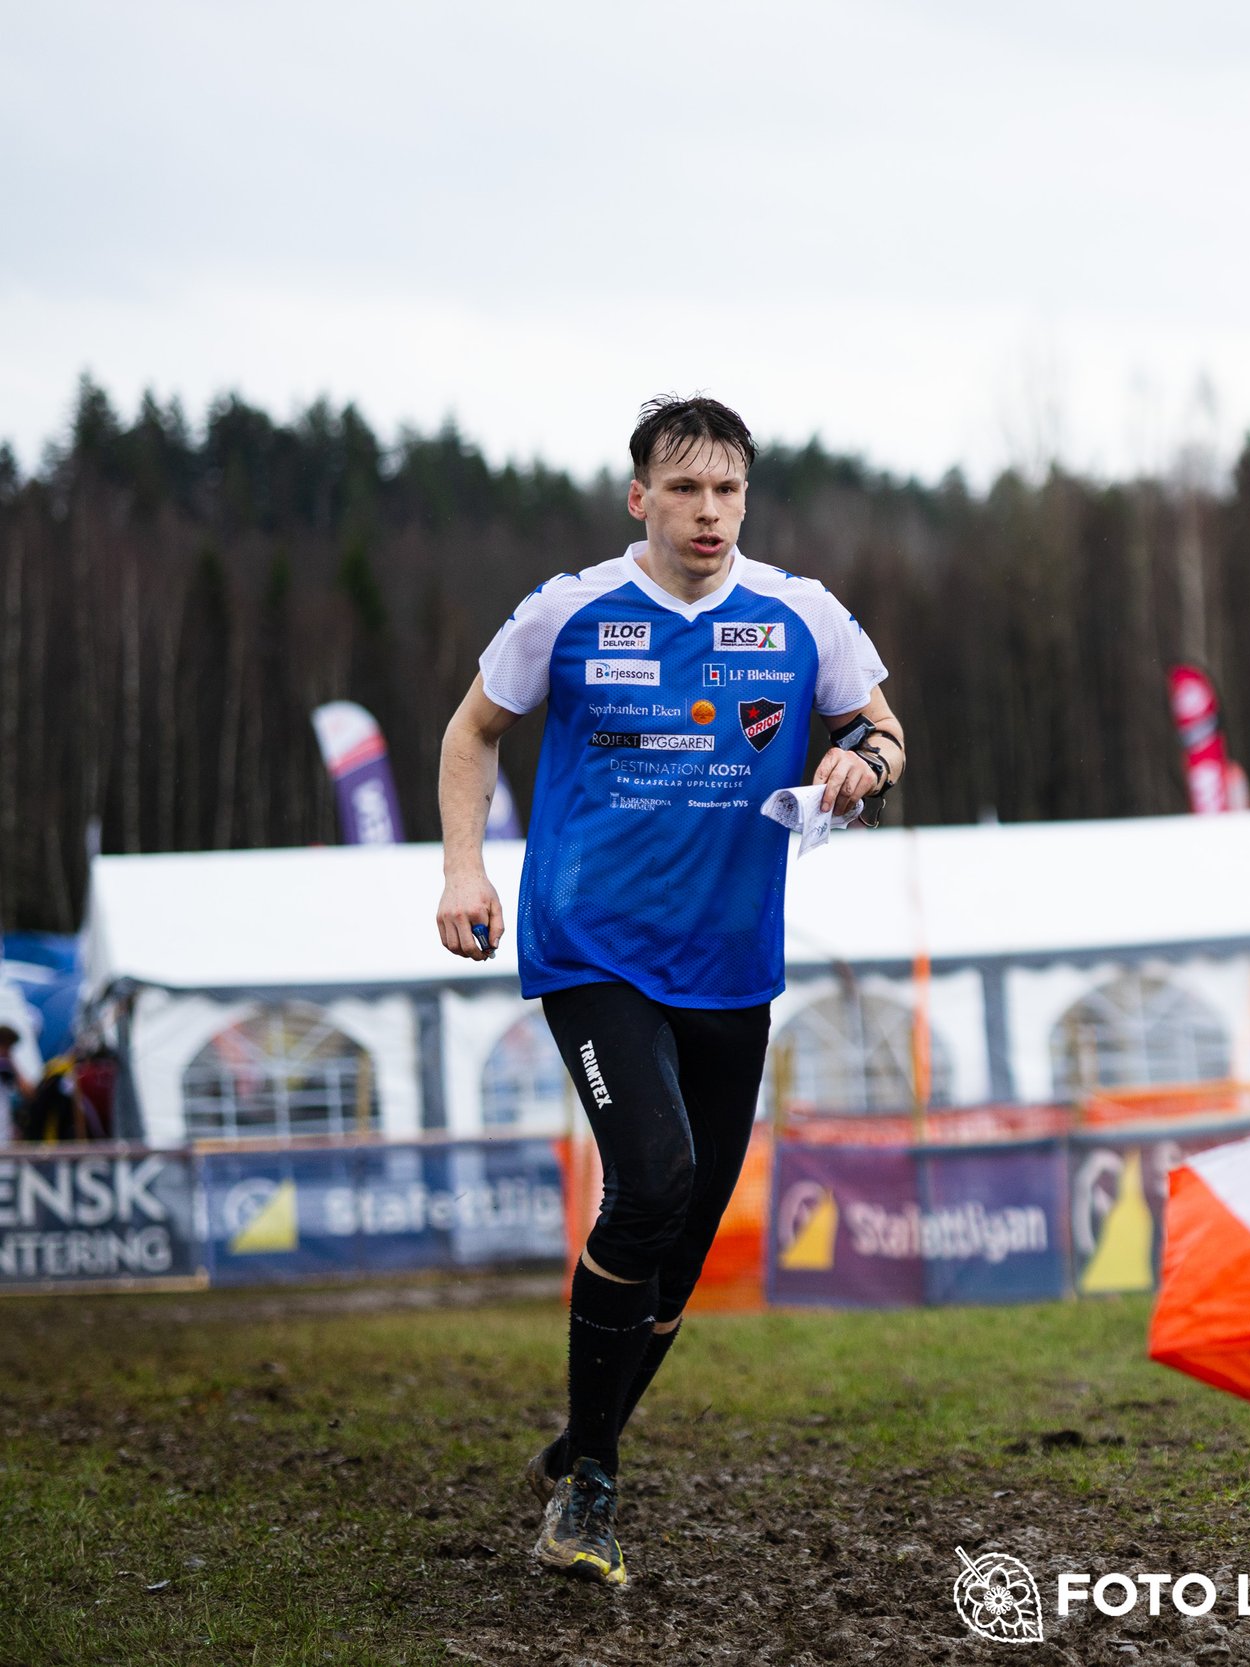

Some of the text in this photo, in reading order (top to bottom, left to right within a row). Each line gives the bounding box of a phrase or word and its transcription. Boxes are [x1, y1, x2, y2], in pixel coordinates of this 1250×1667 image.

[604, 624, 646, 638] iLOG
[729, 669, 795, 683] LF Blekinge
[652, 704, 681, 717] Eken
[748, 711, 781, 737] ORION
[610, 759, 752, 776] DESTINATION KOSTA
[617, 776, 743, 788] EN GLASKLAR UPPLEVELSE
[580, 1040, 612, 1109] TRIMTEX
